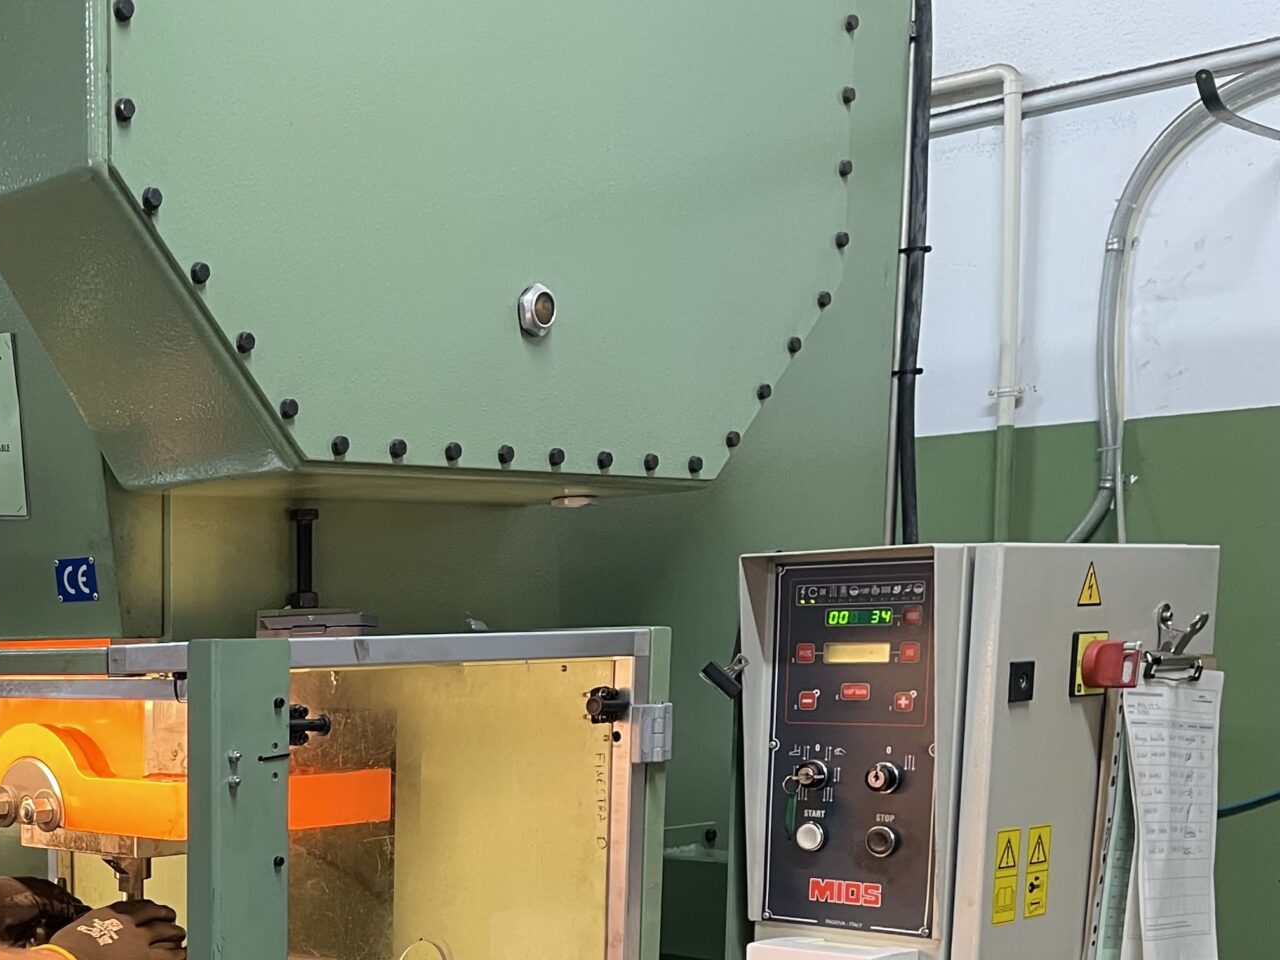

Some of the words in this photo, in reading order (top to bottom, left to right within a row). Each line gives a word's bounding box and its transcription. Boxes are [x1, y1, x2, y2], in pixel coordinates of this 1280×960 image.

[63, 564, 90, 594] CE
[870, 610, 891, 623] 34
[804, 809, 825, 818] START
[876, 813, 895, 822] STOP
[809, 877, 882, 908] MIOS
